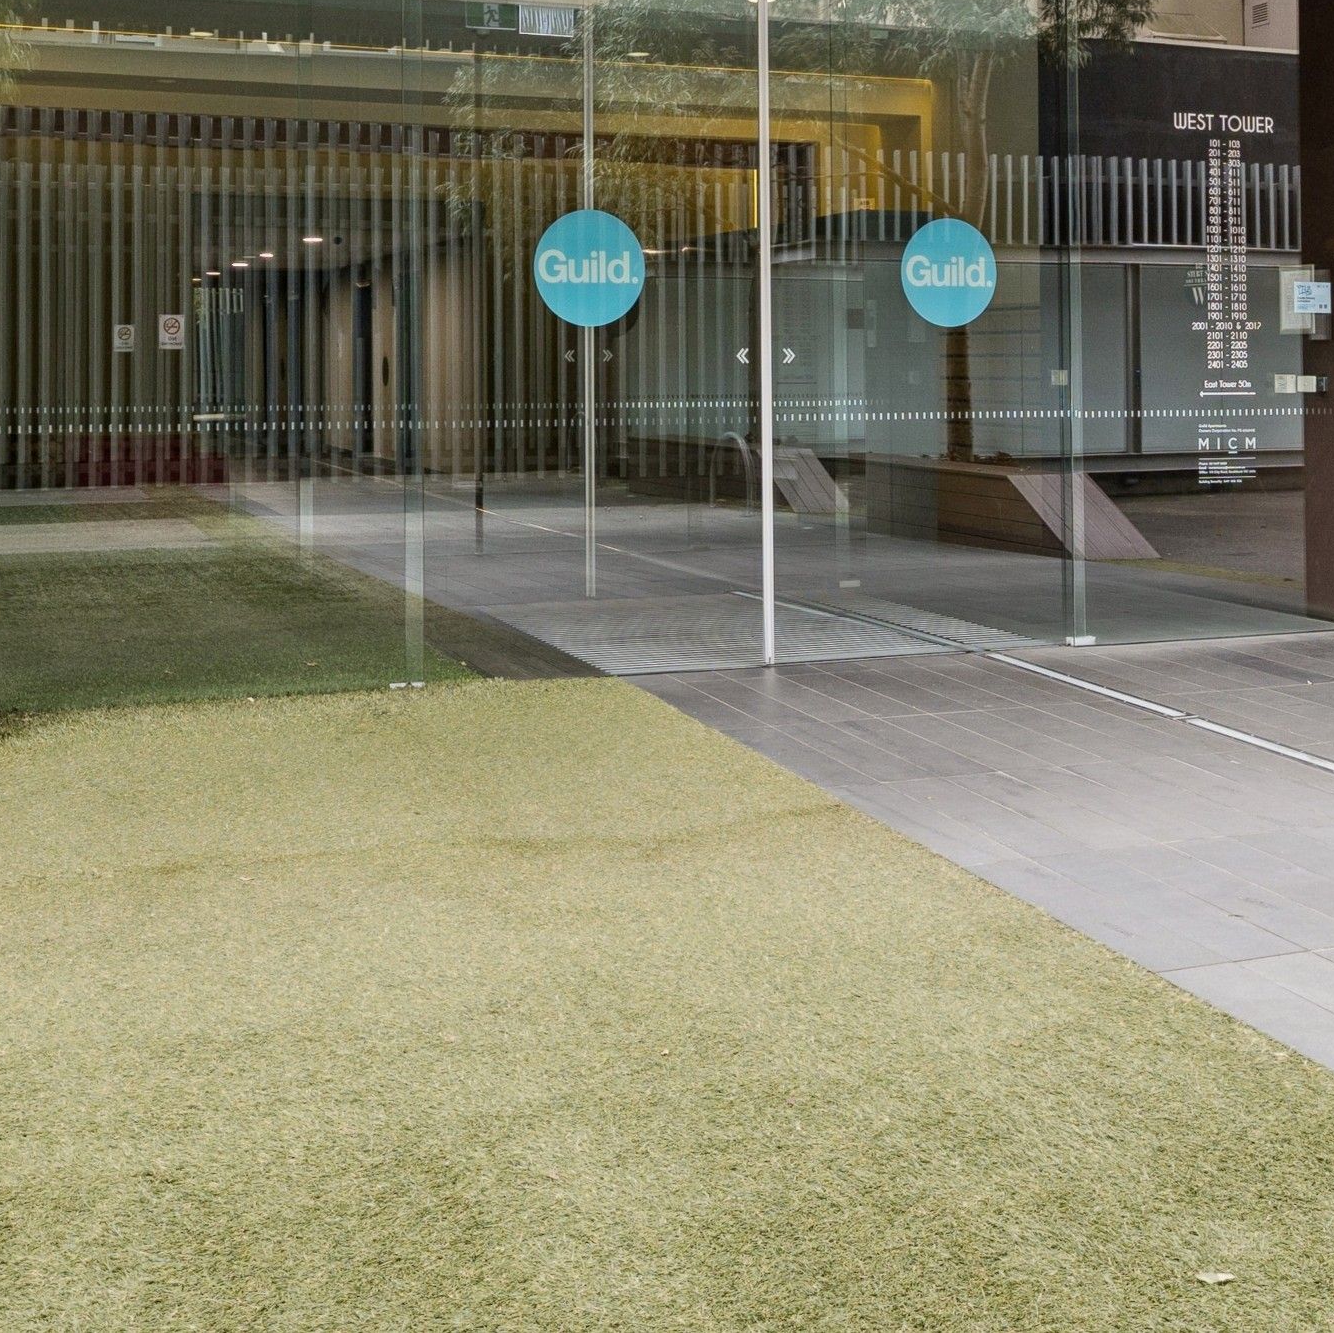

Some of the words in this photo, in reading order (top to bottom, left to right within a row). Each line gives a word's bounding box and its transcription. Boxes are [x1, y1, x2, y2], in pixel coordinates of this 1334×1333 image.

[1173, 112, 1214, 131] WEST
[1220, 115, 1274, 134] TOWER
[1209, 139, 1220, 148] 101
[1229, 140, 1240, 148] 103
[1208, 149, 1220, 157] 201
[1228, 150, 1240, 158] 203
[1228, 159, 1240, 167] 303
[1209, 168, 1220, 176] 401
[1228, 178, 1240, 186] 511
[1209, 187, 1221, 195] 601
[1209, 197, 1221, 205] 701
[1228, 197, 1240, 205] 711
[1209, 216, 1221, 224] 901
[1228, 217, 1240, 225] 911
[1230, 226, 1246, 234] 1010
[1230, 236, 1246, 244] 1110
[1207, 245, 1221, 253] 1201
[1230, 255, 1246, 263] 1310
[538, 249, 639, 285] Guild.
[1207, 264, 1222, 272] 1401
[1230, 265, 1246, 273] 1410
[905, 254, 993, 289] Guild.
[1231, 274, 1246, 282] 1510
[1207, 293, 1222, 301] 1701
[1231, 293, 1247, 301] 1710
[1207, 302, 1222, 310] 1801
[1207, 312, 1223, 320] 1901
[1231, 312, 1247, 320] 1910
[1192, 322, 1208, 330] 2001
[1216, 322, 1233, 330] 2010
[1236, 322, 1241, 330] &
[1245, 322, 1261, 330] 2017
[1207, 341, 1223, 349] 2201
[1230, 341, 1247, 349] 2205
[1207, 351, 1223, 359] 2301
[1231, 351, 1247, 359] 2305
[1207, 361, 1223, 369] 2401
[1231, 360, 1248, 368] 2405
[1204, 380, 1218, 388] East
[1219, 380, 1237, 388] Tower
[1238, 380, 1251, 388] 50m
